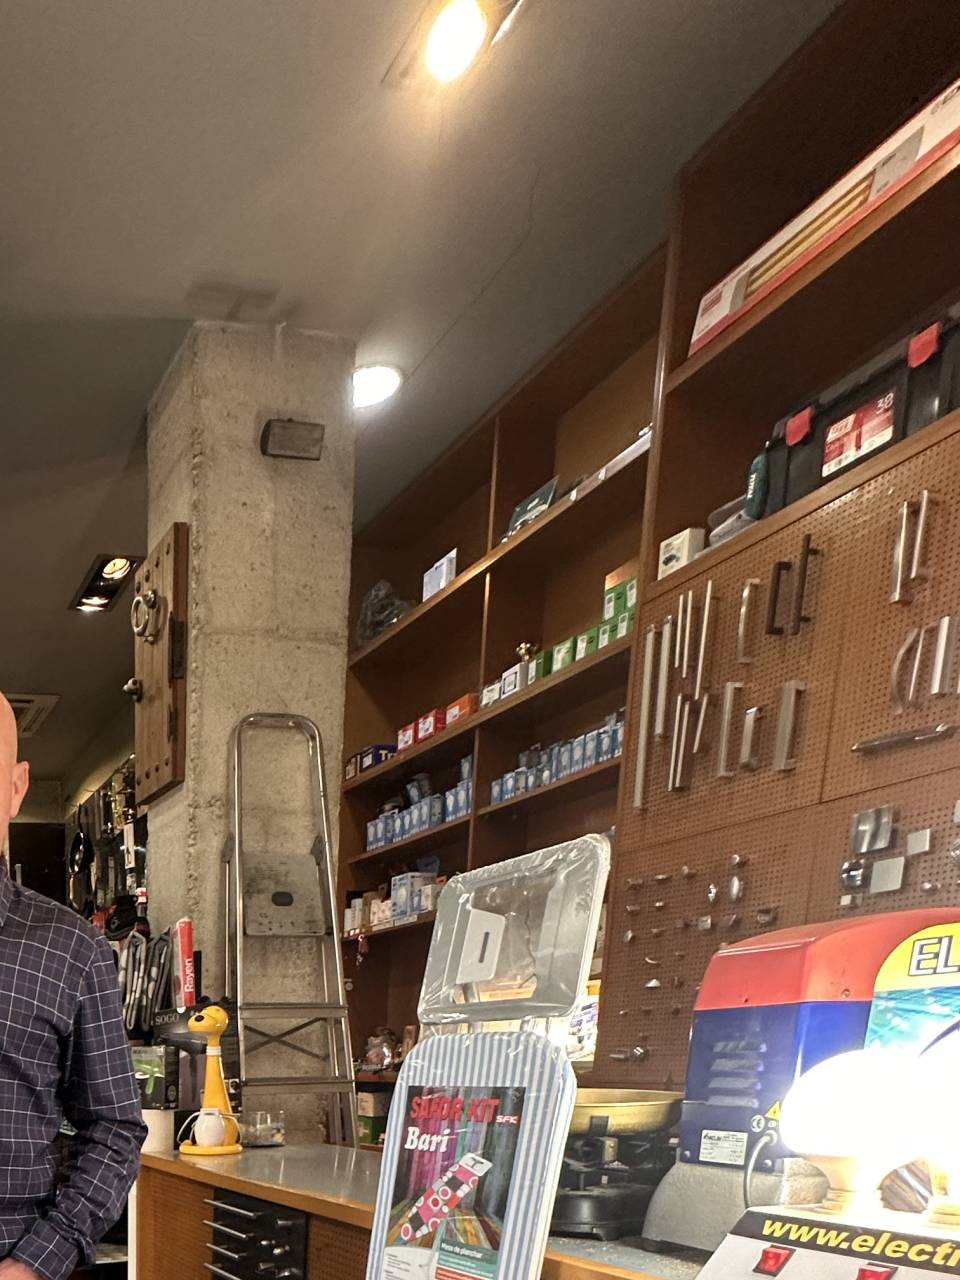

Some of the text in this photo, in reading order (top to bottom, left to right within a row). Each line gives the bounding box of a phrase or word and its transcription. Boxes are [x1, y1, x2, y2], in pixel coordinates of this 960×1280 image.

[184, 958, 195, 993] Rayen
[155, 1013, 180, 1026] SOGO
[467, 1098, 501, 1122] KIT
[496, 1115, 518, 1124] SFK
[404, 1126, 451, 1153] Bari
